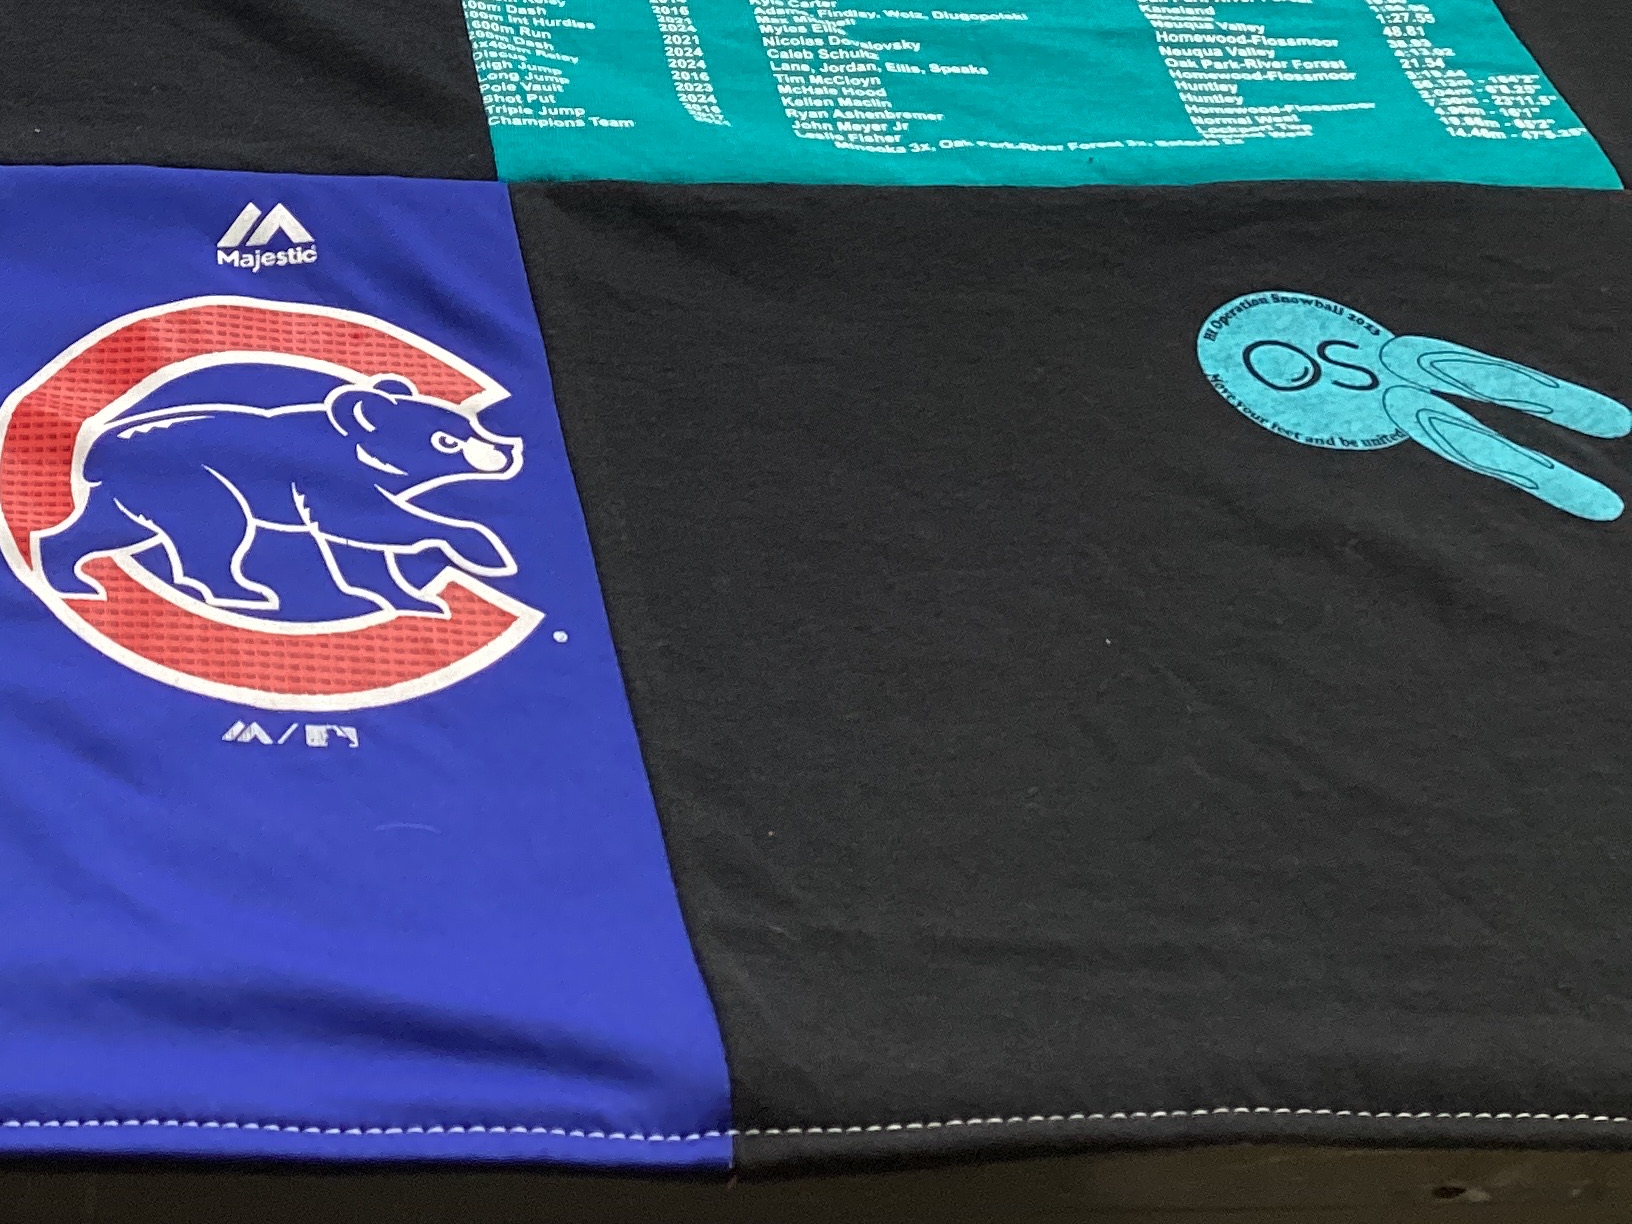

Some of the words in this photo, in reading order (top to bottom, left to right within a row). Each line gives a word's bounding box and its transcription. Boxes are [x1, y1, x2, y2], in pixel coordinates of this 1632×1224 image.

[762, 36, 824, 47] Nicolas
[664, 46, 704, 57] 2024
[766, 49, 814, 59] Caleb
[1158, 45, 1224, 59] Neuqua
[1225, 46, 1275, 59] Valley
[667, 58, 706, 69] 2024
[770, 61, 815, 74] Lane,
[819, 62, 882, 73] Jordan,
[773, 73, 805, 84] Tim
[520, 82, 564, 93] Vault
[526, 93, 557, 104] Put
[538, 106, 586, 117] Jump
[588, 117, 635, 128] Team
[792, 121, 833, 131] John
[216, 245, 317, 272] Majestic
[1215, 295, 1268, 326] Operation
[1271, 293, 1345, 316] Snowball
[1242, 340, 1380, 391] OS
[1305, 436, 1335, 446] and
[1340, 438, 1358, 448] be
